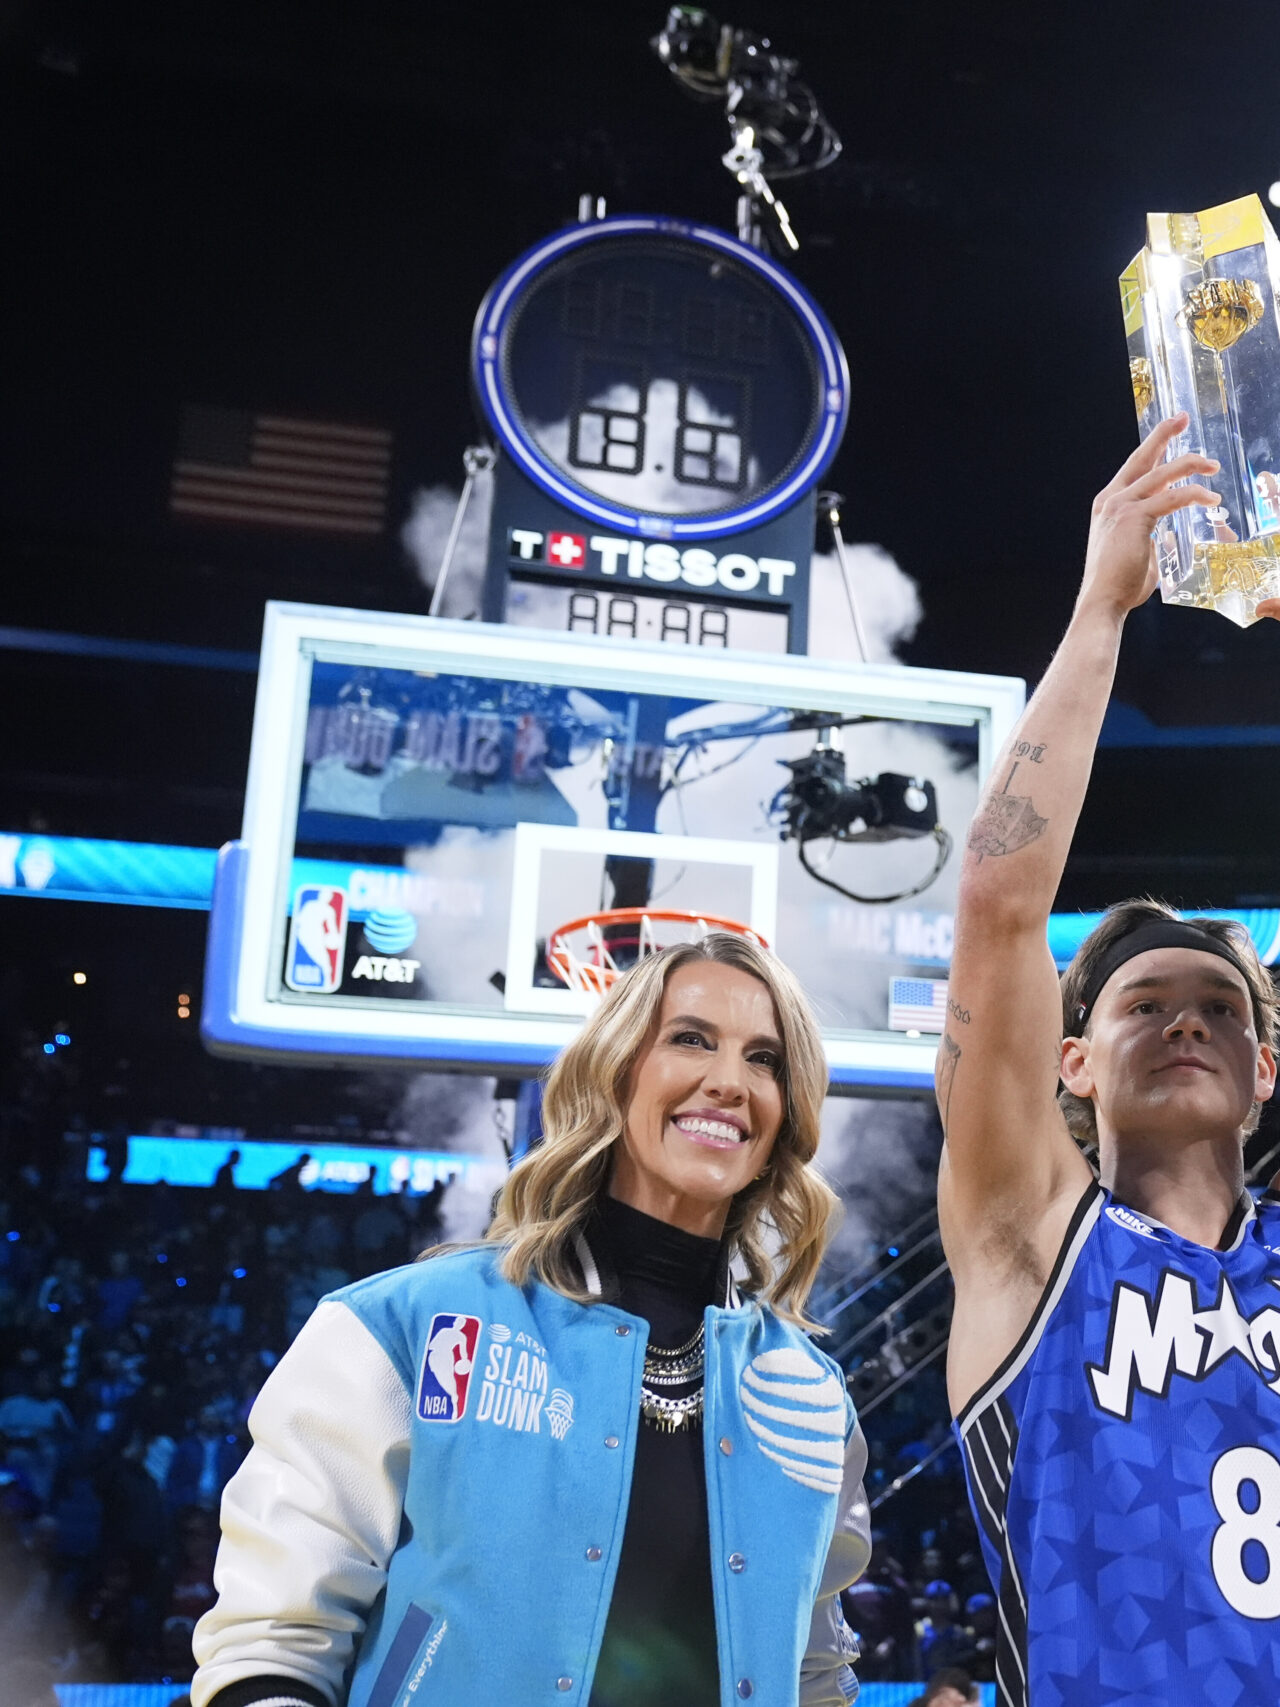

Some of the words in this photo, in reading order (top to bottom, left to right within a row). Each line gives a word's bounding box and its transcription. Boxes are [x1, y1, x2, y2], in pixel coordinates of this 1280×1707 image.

[590, 536, 797, 596] TISSOT
[352, 956, 421, 984] AT&T
[515, 1331, 547, 1357] AT&T
[484, 1343, 548, 1396] SLAM
[423, 1395, 448, 1416] NBA
[475, 1380, 546, 1433] DUNK
